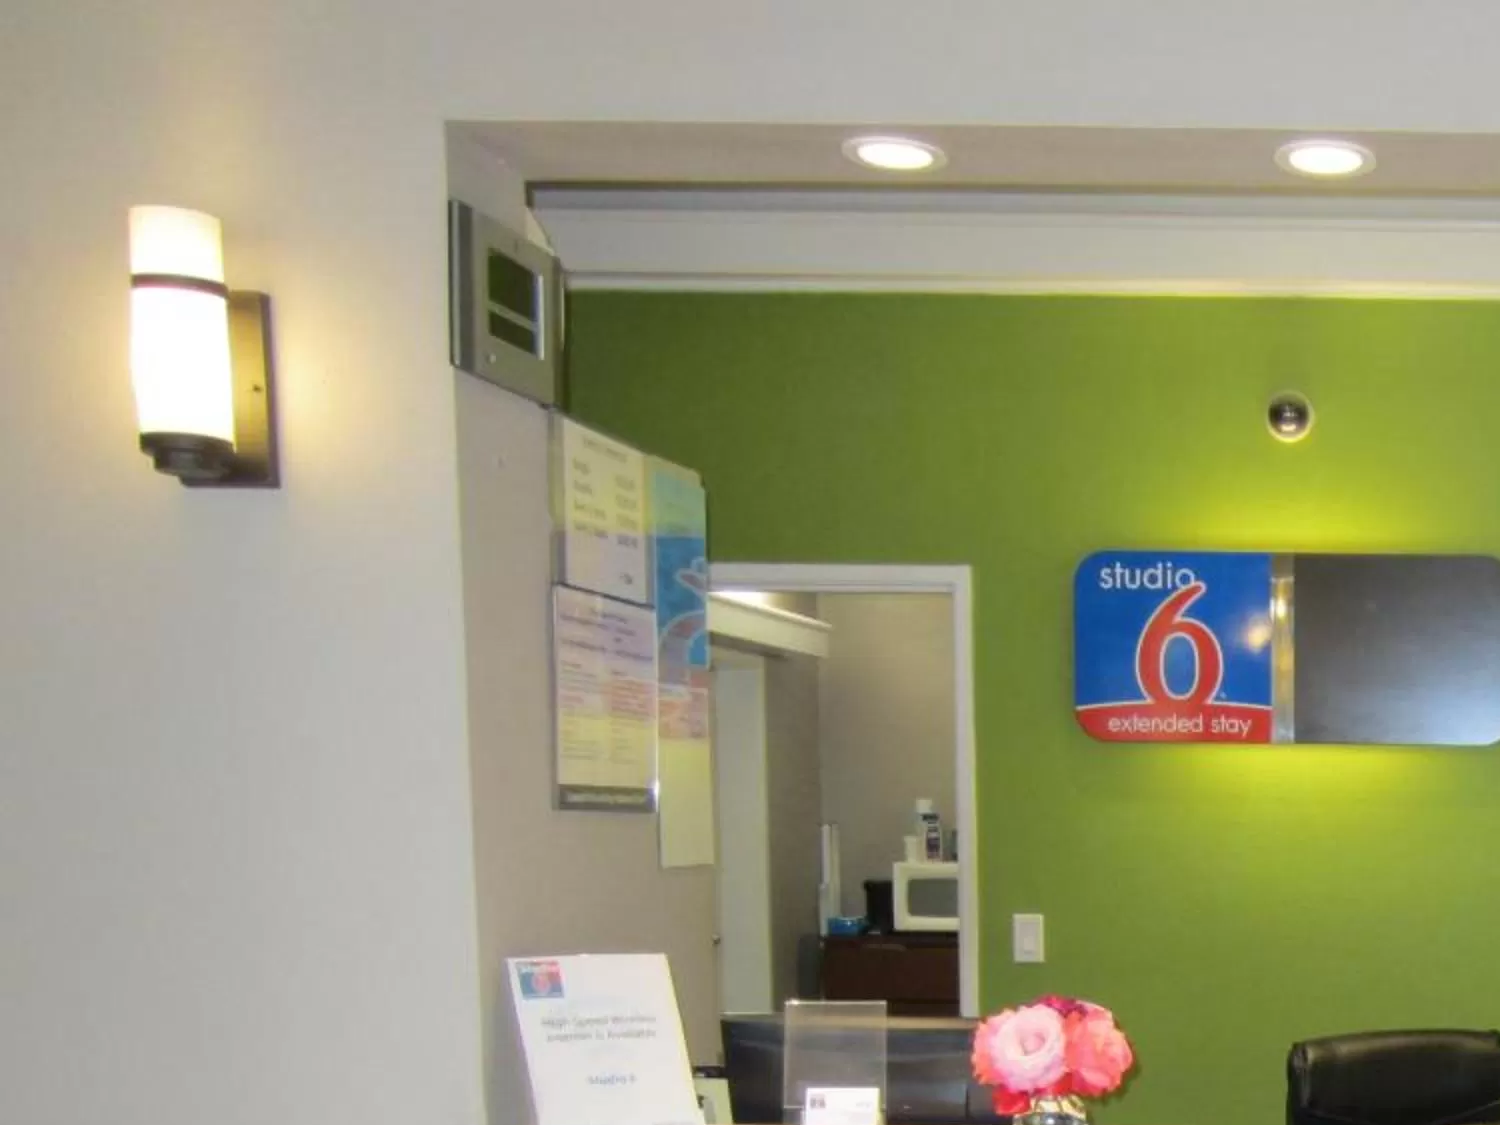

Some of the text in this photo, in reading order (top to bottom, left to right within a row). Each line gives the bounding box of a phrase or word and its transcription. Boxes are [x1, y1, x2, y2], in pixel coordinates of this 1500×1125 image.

[1099, 561, 1196, 591] studio
[1136, 580, 1224, 704] 6
[1107, 714, 1253, 738] extended stay
